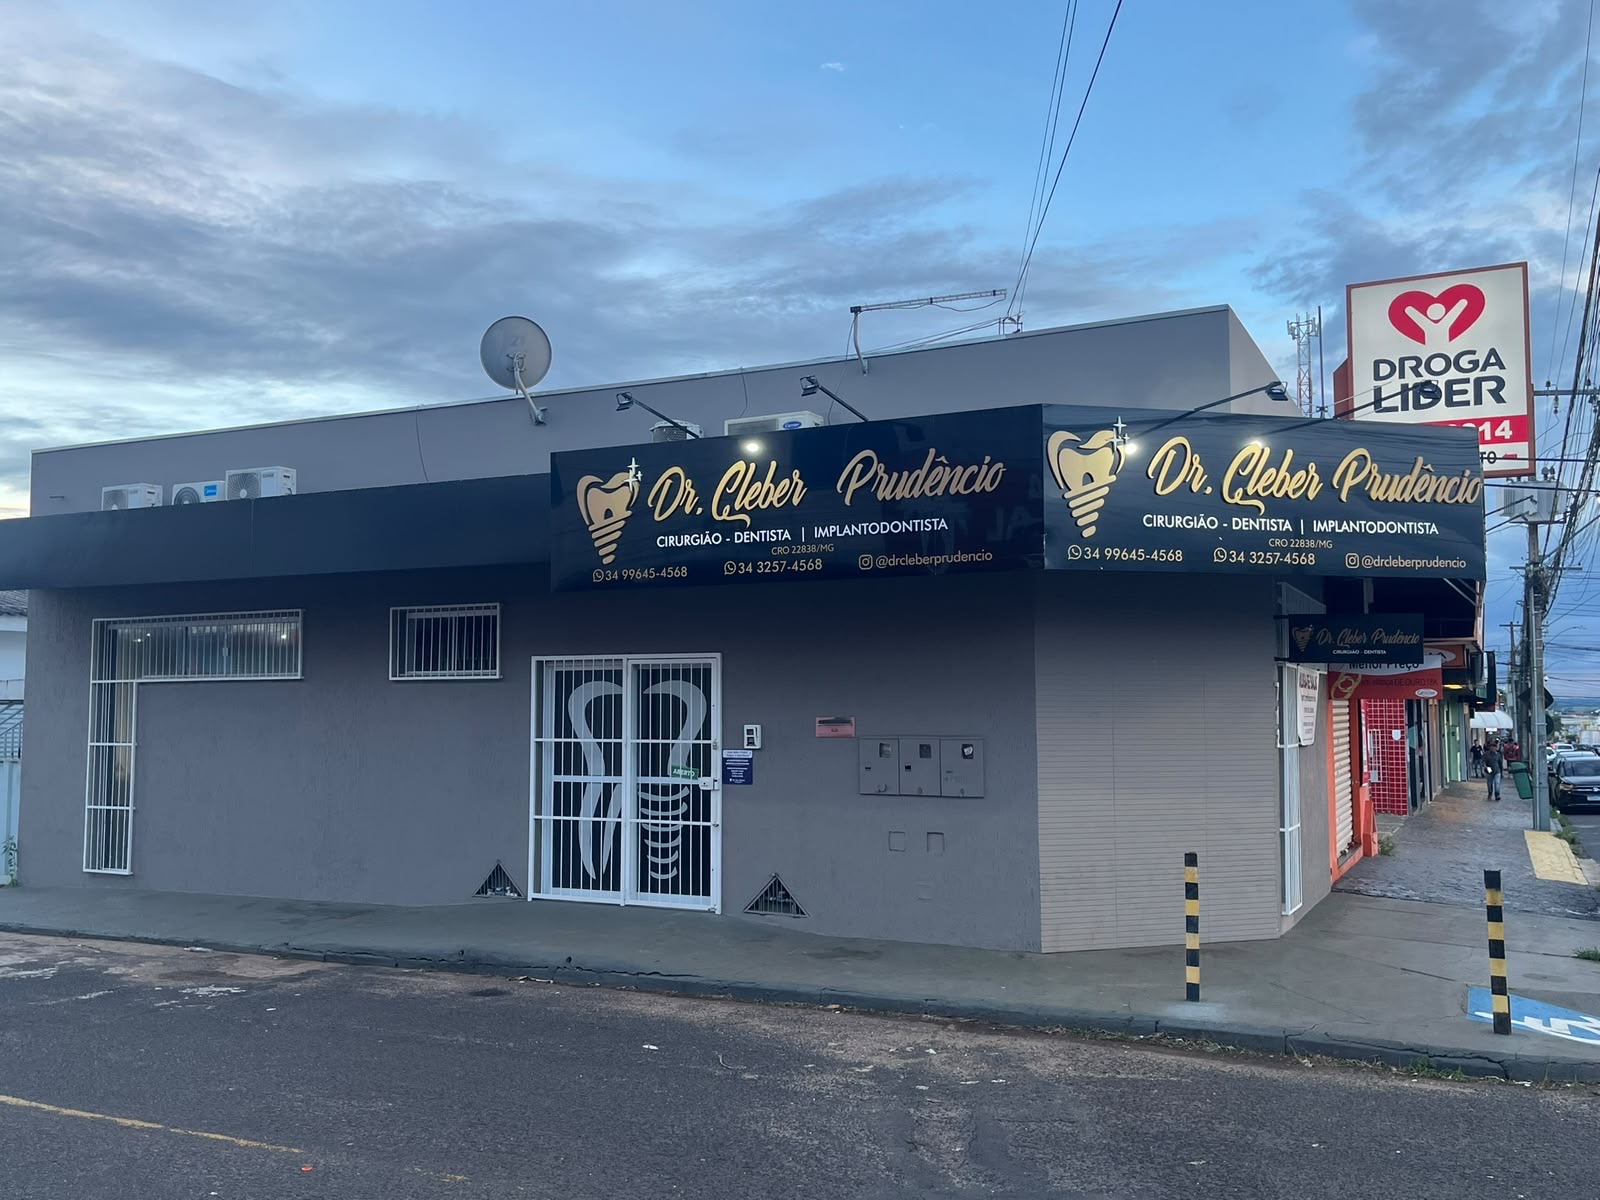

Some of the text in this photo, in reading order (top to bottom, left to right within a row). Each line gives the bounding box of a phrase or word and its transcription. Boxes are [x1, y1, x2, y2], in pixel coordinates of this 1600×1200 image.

[1373, 348, 1506, 382] DROGA
[1147, 436, 1483, 515] Dr. Cleber Prudêncio
[647, 448, 1007, 527] Dr. Cleber Prudêncio
[656, 531, 722, 548] CIRURGIÃO
[734, 529, 792, 544] DENTISTA
[814, 518, 949, 539] IMPLANTODONTISTA
[1142, 514, 1218, 530] CIRURGIÃO
[1232, 517, 1293, 533] DENTISTA
[1313, 519, 1439, 535] IMPLANTODONTISTA
[771, 543, 834, 555] CRO 22838/MG
[1268, 538, 1333, 549] CRO 22838/MG
[875, 550, 993, 570] @drcleberprudencio
[1084, 547, 1183, 562] 34 99645-4568
[1229, 550, 1316, 566] 34 3257-4568
[1361, 555, 1467, 570] @drcleberprudencio
[605, 566, 688, 582] 34 99645-4568
[738, 559, 823, 574] 34 3257-4568
[1315, 628, 1335, 645] Dr.
[1336, 628, 1367, 649] Cleber
